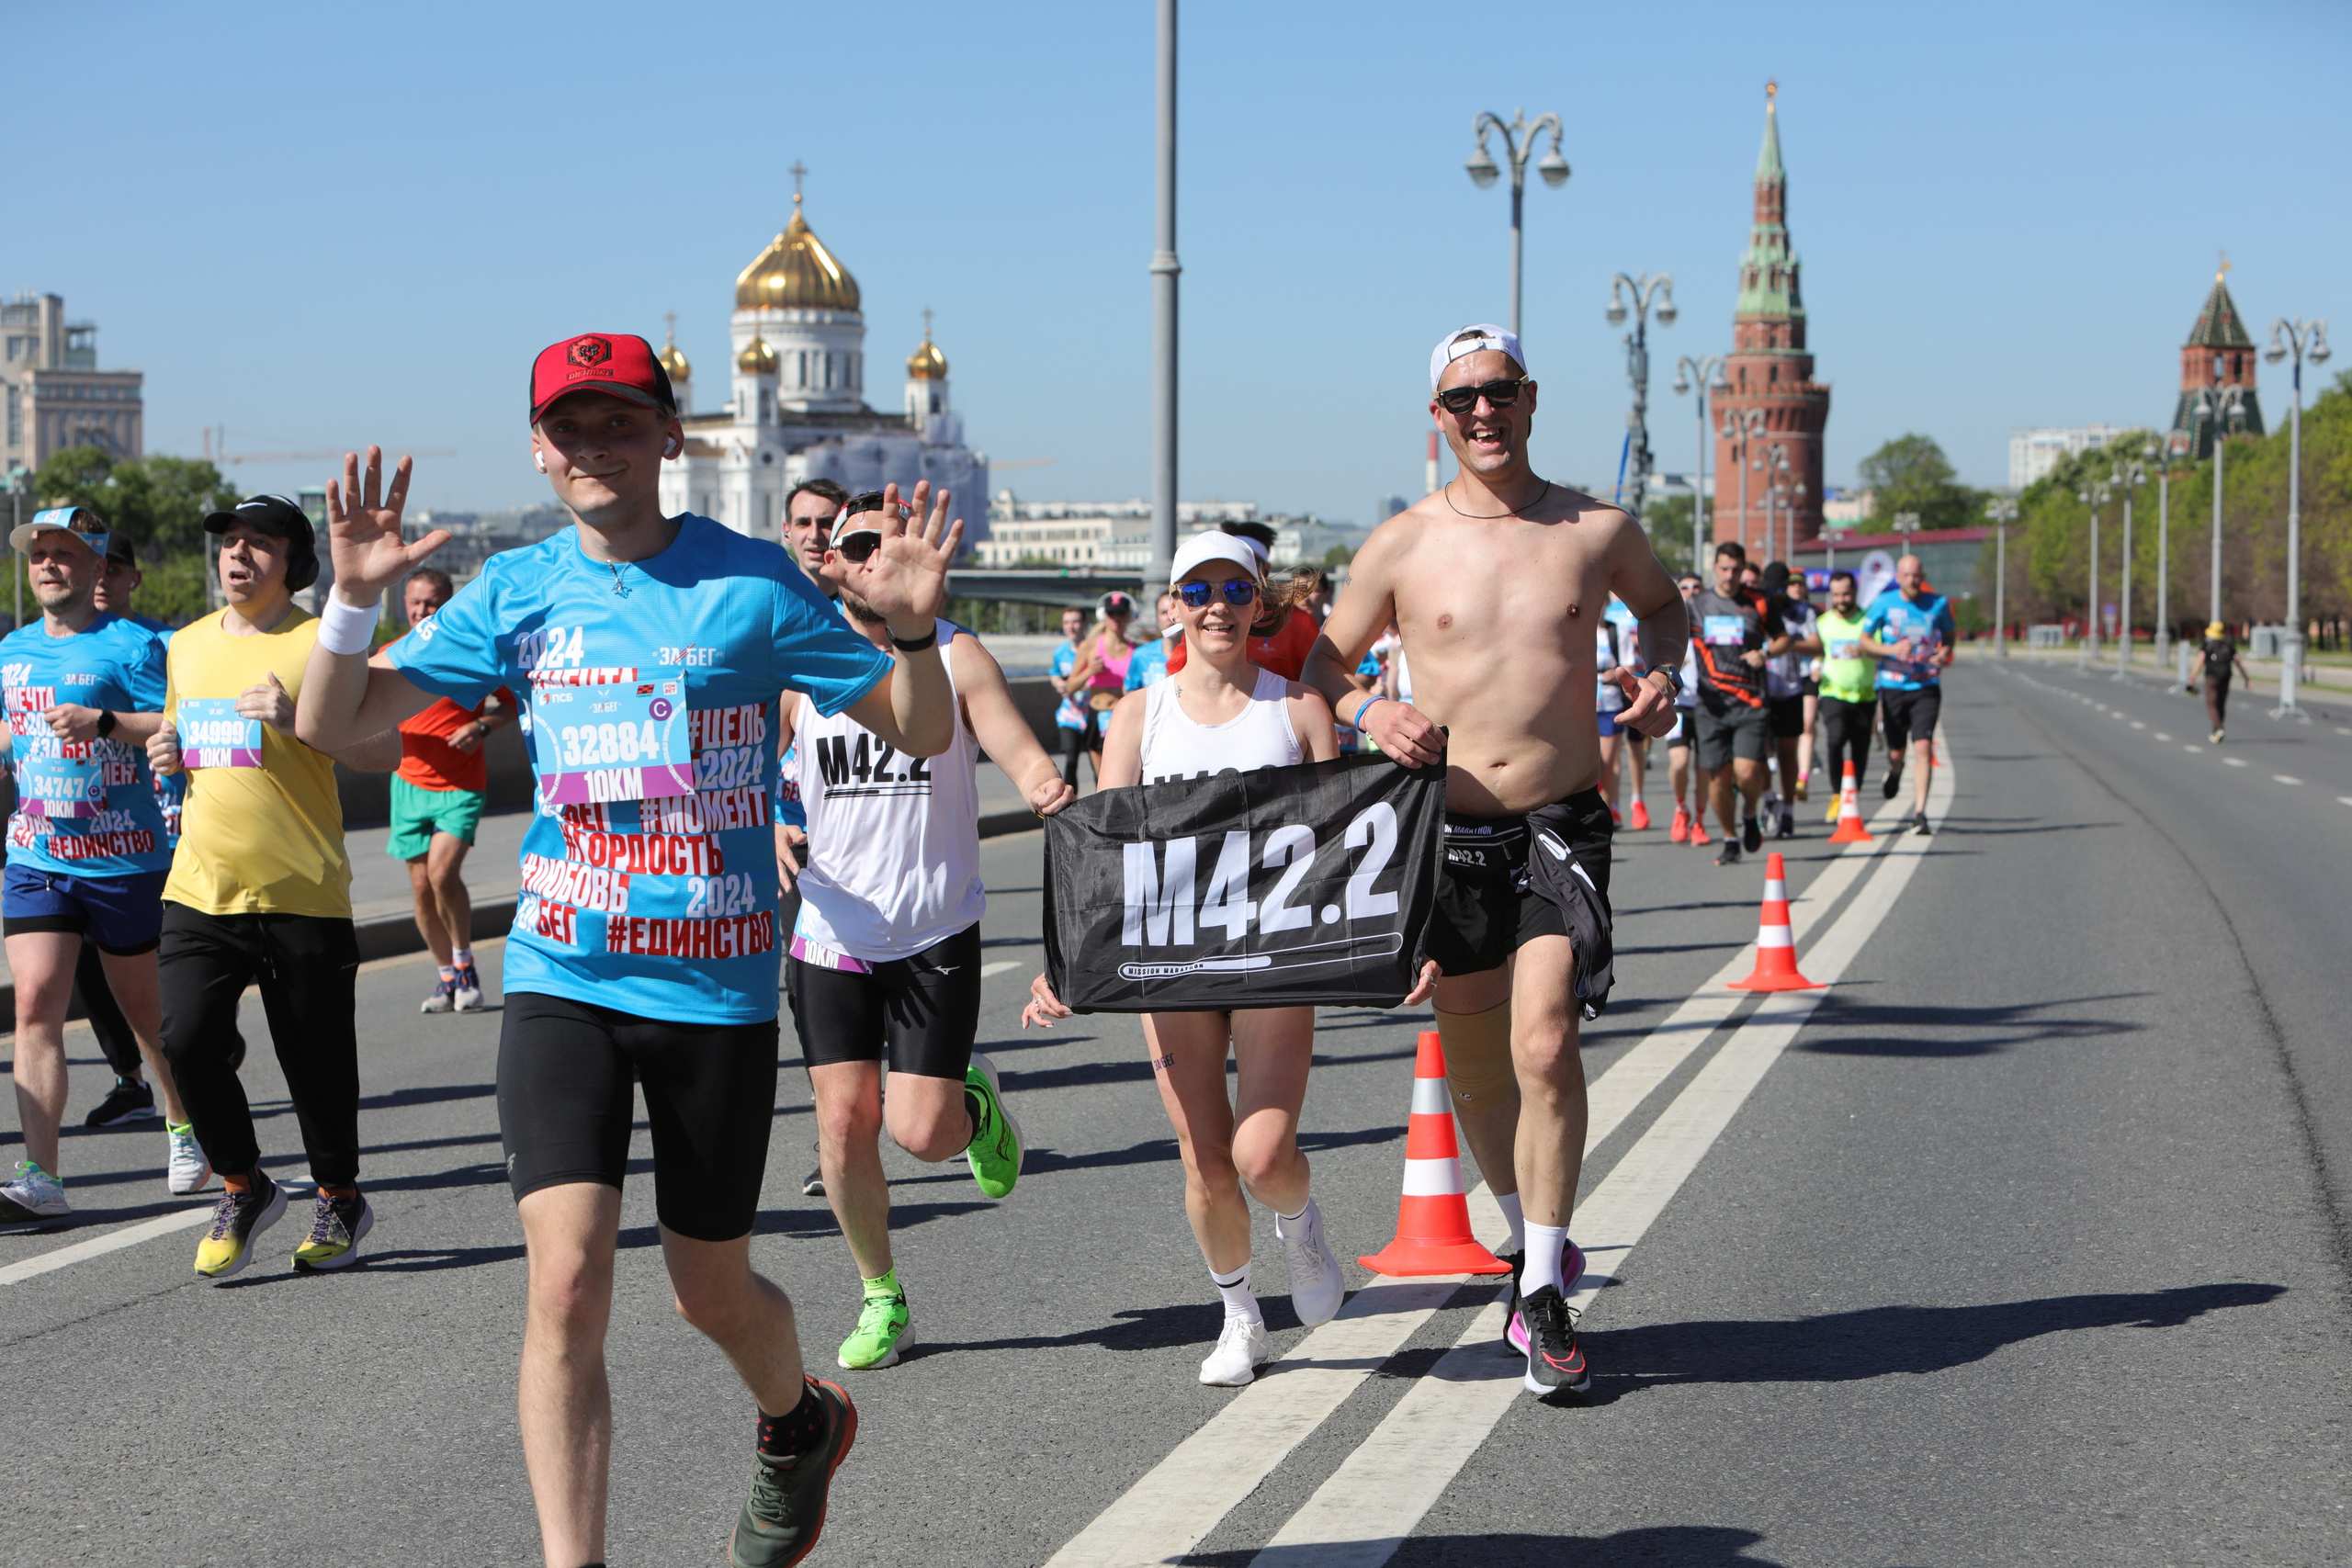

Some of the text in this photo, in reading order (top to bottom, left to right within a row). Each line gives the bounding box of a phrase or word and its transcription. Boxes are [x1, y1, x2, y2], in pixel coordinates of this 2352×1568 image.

[514, 626, 584, 670] 2024
[552, 693, 573, 703] ПСБ
[653, 701, 667, 717] C
[27, 712, 56, 736] 202
[189, 720, 244, 745] 34999
[688, 704, 766, 750] #ЦЕЛЬ
[198, 747, 232, 768] 10KM
[561, 719, 660, 767] 32884
[101, 761, 140, 784] МЕНТ
[701, 746, 764, 790] 2024
[34, 775, 85, 798] 34747
[583, 766, 644, 803] 10KM
[42, 800, 75, 818] 10KM
[639, 784, 769, 833] #МОМЕНТ
[49, 829, 154, 859] #ЕДИНСТВО
[560, 823, 725, 875] #ГОРДОСТЬ
[521, 853, 756, 918] #ЛЮБОВЬ 2024
[1122, 801, 1398, 946] M42.2
[606, 909, 774, 959] #ЕДИНСТВО
[804, 940, 840, 969] 10KM
[1163, 964, 1204, 975] MARATHON
